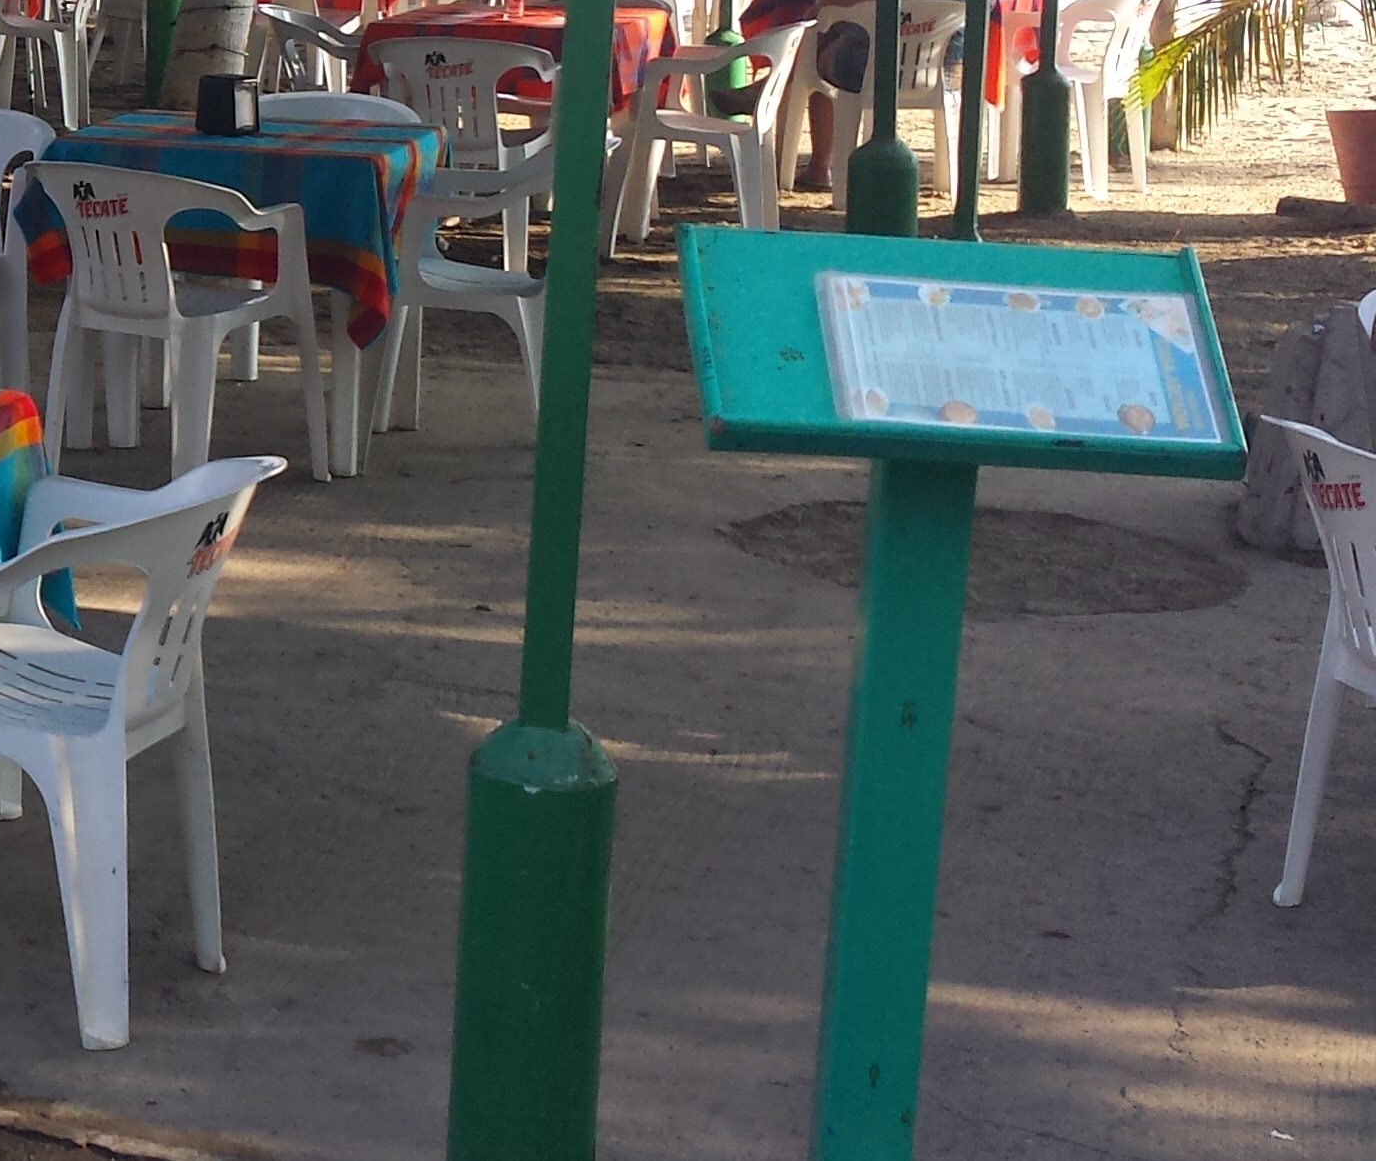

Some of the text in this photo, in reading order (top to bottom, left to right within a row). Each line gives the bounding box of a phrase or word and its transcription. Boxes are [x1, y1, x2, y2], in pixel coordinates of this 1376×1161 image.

[426, 58, 474, 79] TECATE
[77, 196, 129, 219] TECATE
[1312, 482, 1366, 511] TECATE
